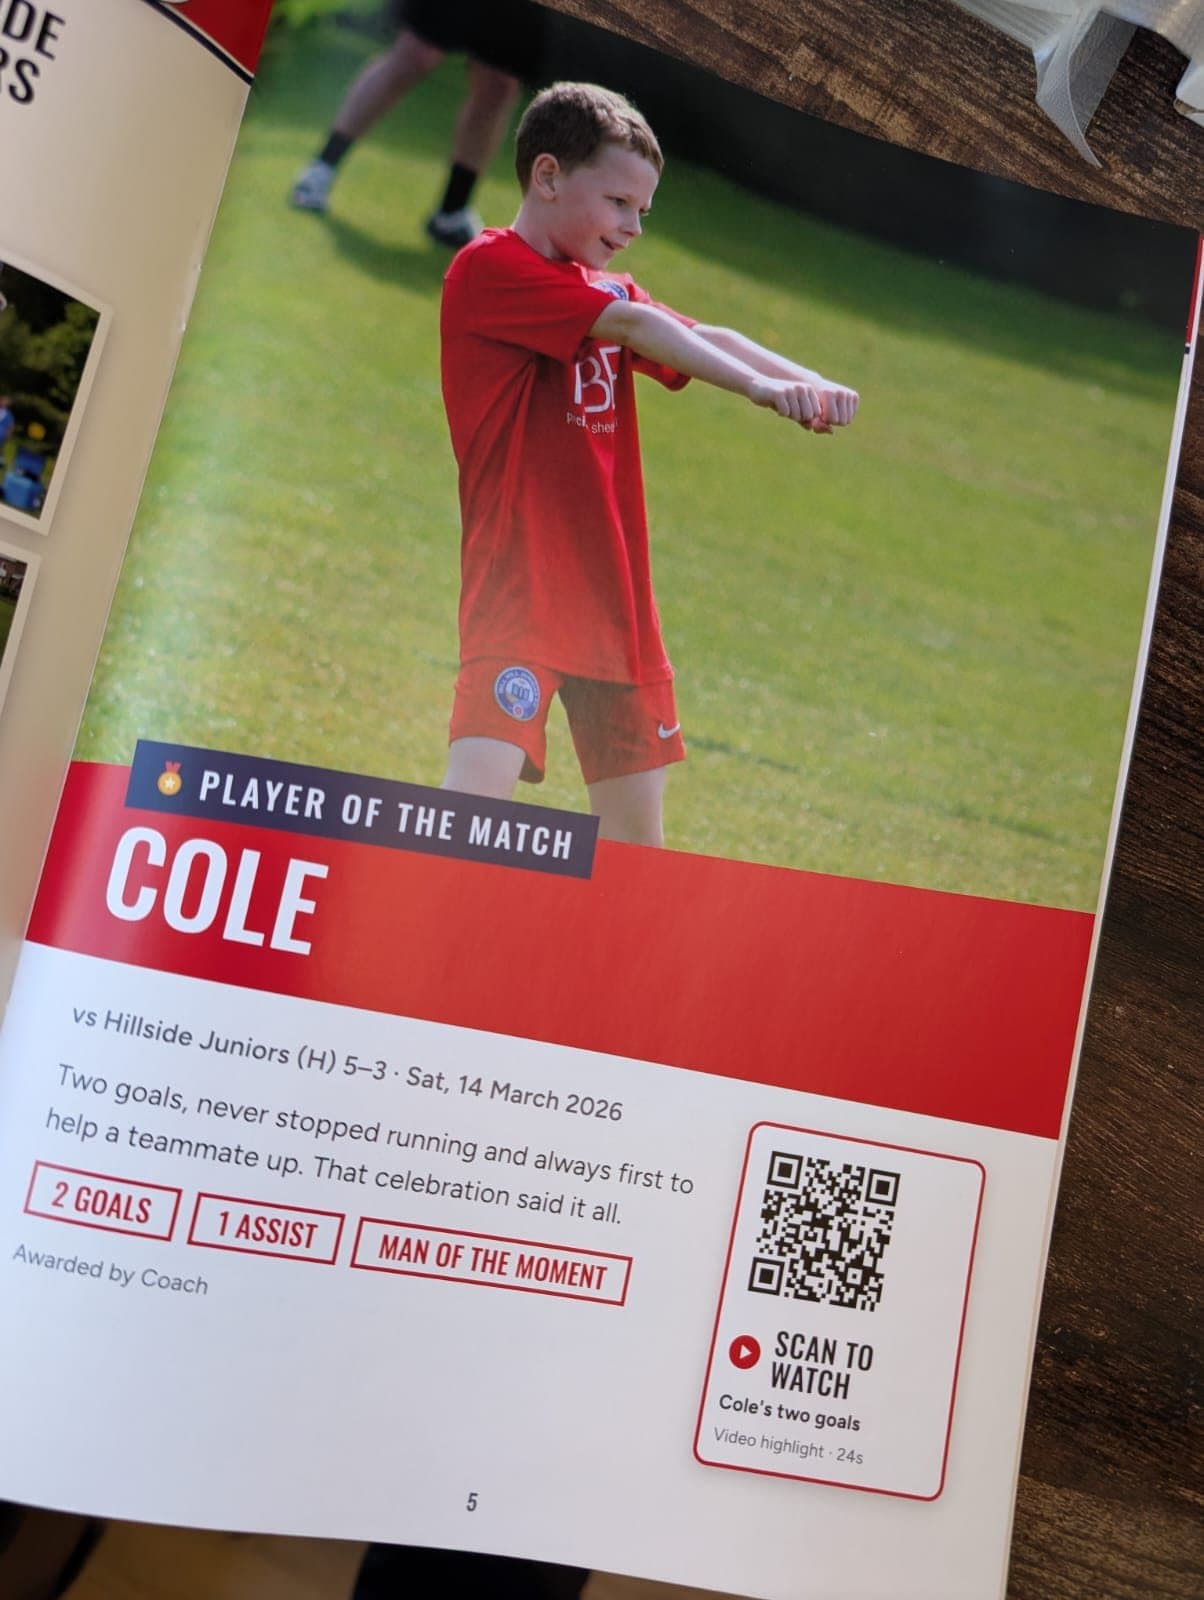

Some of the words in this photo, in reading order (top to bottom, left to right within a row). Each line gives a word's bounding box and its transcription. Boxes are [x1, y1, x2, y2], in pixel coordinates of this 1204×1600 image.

[0, 0, 66, 61] DE
[199, 769, 326, 820] PLAYER
[341, 793, 383, 829] OF
[397, 802, 456, 841] THE
[468, 814, 574, 861] MATCH
[105, 825, 330, 957] COLE
[72, 1007, 97, 1027] vs
[104, 1010, 193, 1047] Hillside
[199, 1031, 290, 1065] Juniors
[297, 1045, 337, 1075] (H)
[406, 1066, 450, 1094] Sat,
[458, 1075, 483, 1097] 14
[489, 1080, 560, 1110] March
[565, 1094, 623, 1122] 2026
[58, 1063, 108, 1094] Two
[114, 1080, 188, 1114] goals,
[196, 1097, 269, 1125] never
[275, 1109, 380, 1144] stopped
[386, 1127, 478, 1163] running
[484, 1145, 529, 1167] and
[534, 1150, 612, 1183] always
[618, 1163, 664, 1190] first
[670, 1172, 695, 1195] to
[46, 1107, 98, 1142] help
[105, 1124, 119, 1143] a
[128, 1125, 260, 1168] teammate
[267, 1151, 304, 1178] up.
[313, 1156, 368, 1185] That
[375, 1170, 510, 1207] celebration
[517, 1192, 564, 1215] said
[570, 1196, 587, 1218] it
[592, 1202, 622, 1225] all.
[51, 1181, 69, 1209] 2
[74, 1185, 153, 1224] GOALS
[219, 1210, 229, 1236] 1
[235, 1213, 319, 1250] ASSIST
[12, 1243, 103, 1278] Awarded
[109, 1263, 136, 1287] by
[141, 1268, 209, 1295] Coach
[378, 1234, 430, 1265] MAN
[435, 1241, 464, 1270] OF
[471, 1247, 511, 1276] THE
[515, 1254, 609, 1291] MOMENT
[774, 1330, 838, 1366] SCAN
[846, 1341, 874, 1372] TO
[770, 1361, 851, 1400] WATCH
[719, 1394, 772, 1418] Cole's
[777, 1403, 811, 1424] two
[815, 1411, 861, 1432] goals
[714, 1426, 757, 1447] Video
[760, 1434, 825, 1459] highlight
[836, 1447, 864, 1465] 24s
[466, 1491, 479, 1513] 5
